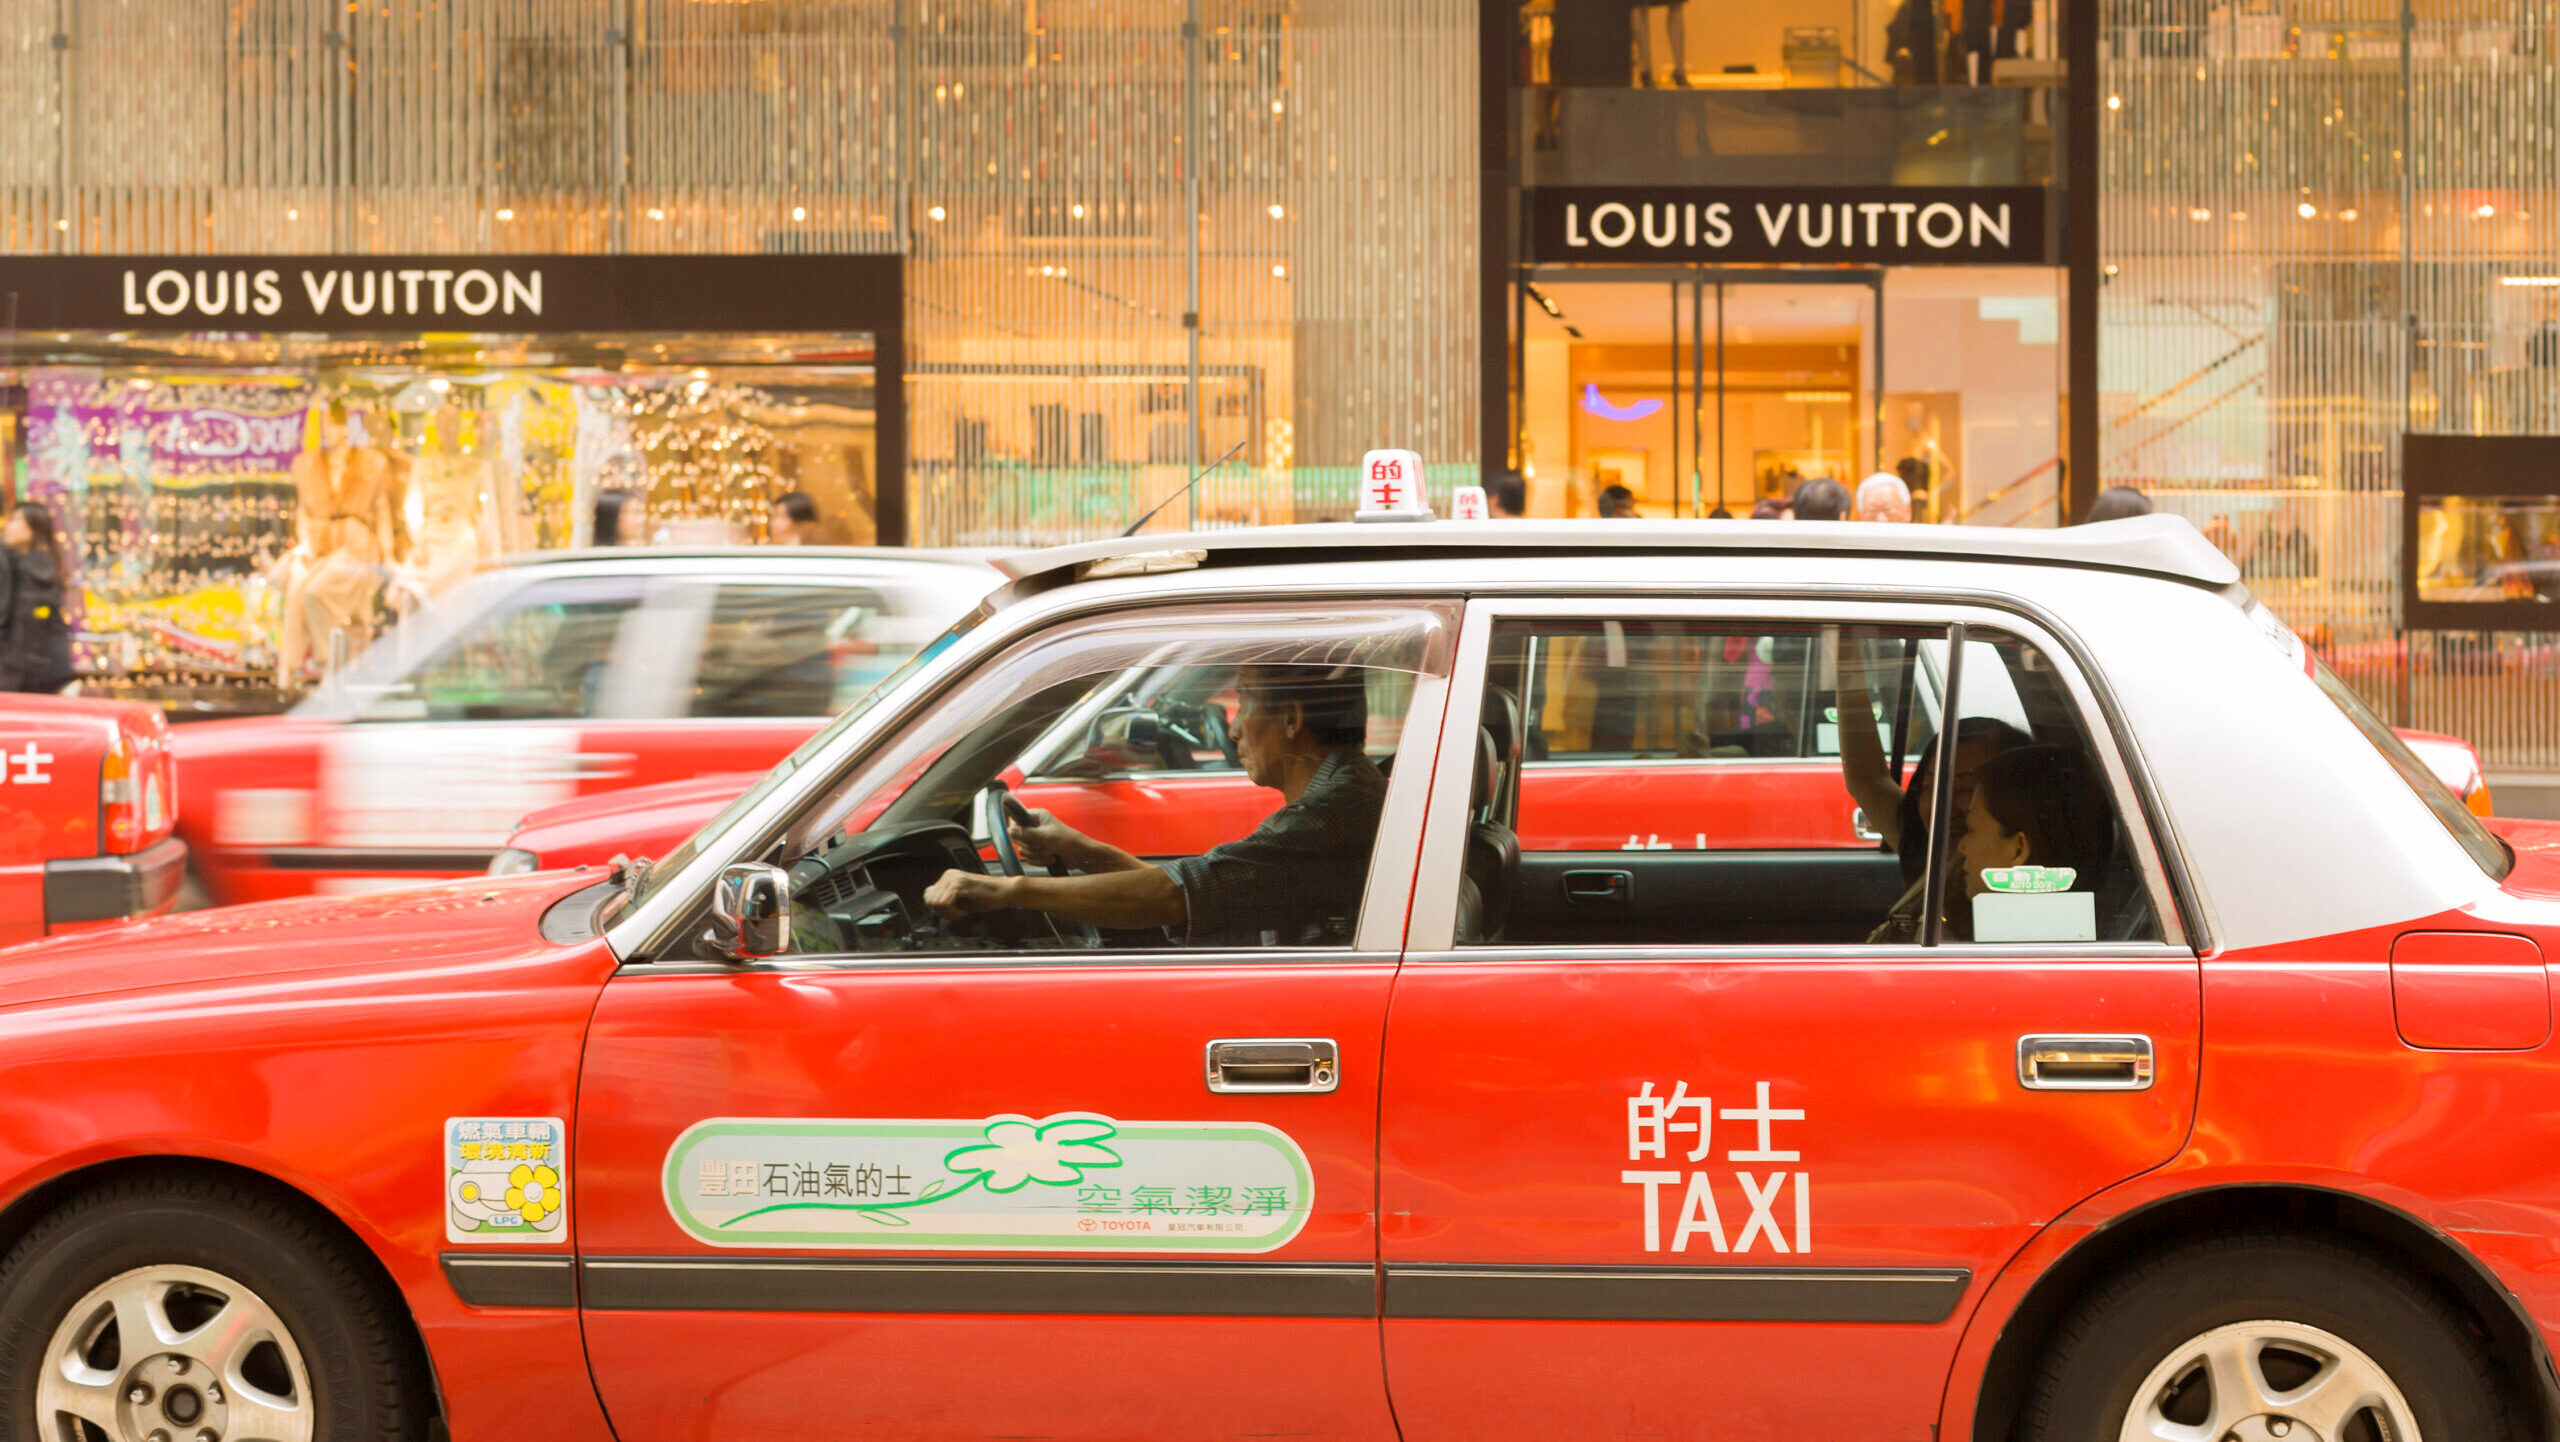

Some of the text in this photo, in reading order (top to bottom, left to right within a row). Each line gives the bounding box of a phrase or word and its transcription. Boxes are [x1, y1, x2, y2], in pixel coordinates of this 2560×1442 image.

[1566, 203, 2010, 248] LOUIS VUITTON
[123, 270, 543, 316] LOUIS VUITTON
[1371, 459, 1403, 504] 的士
[0, 740, 55, 785] 士
[1627, 1079, 1806, 1163] 的士
[1076, 1183, 1291, 1217] 空氣潔淨
[1621, 1170, 1812, 1254] TAXI
[1100, 1220, 1152, 1232] TOYOTA
